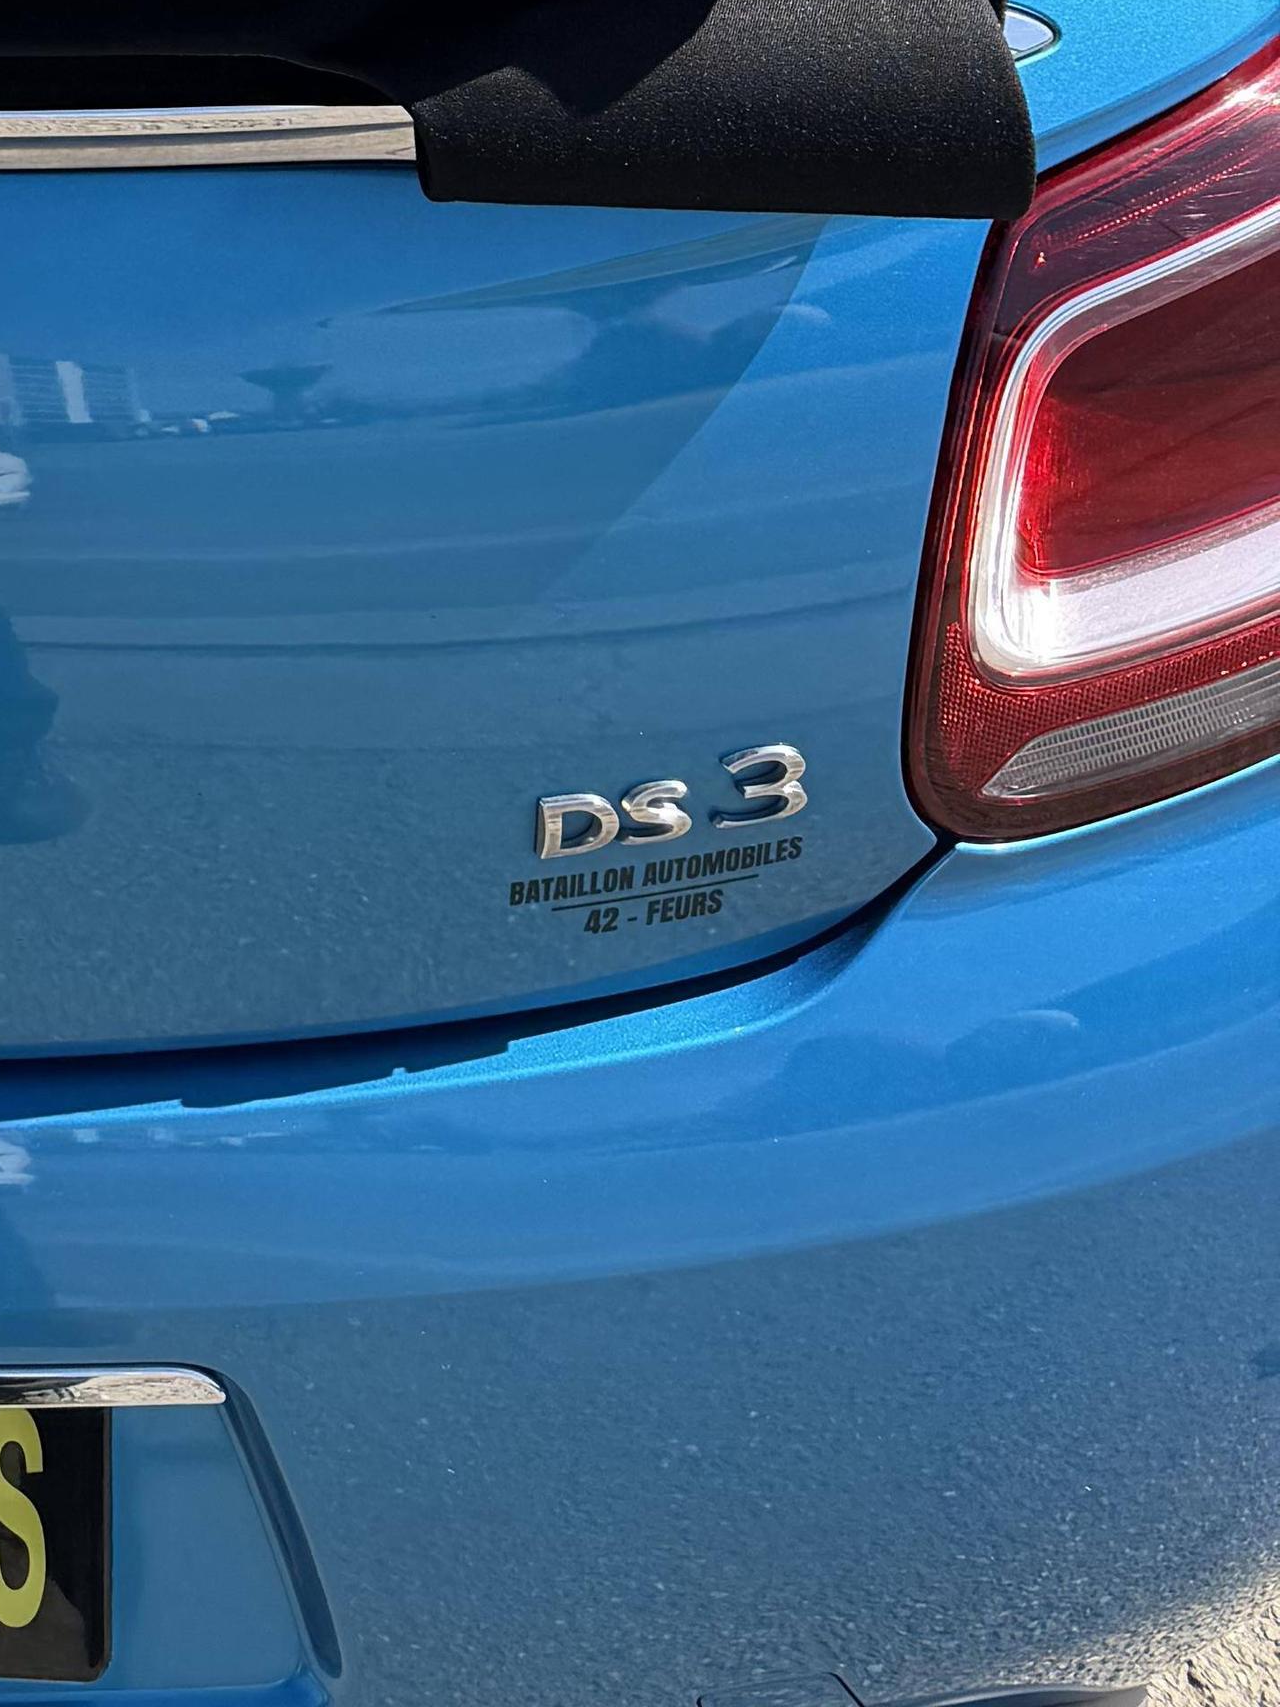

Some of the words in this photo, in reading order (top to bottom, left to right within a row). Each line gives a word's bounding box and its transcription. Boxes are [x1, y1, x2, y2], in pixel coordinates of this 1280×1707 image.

[536, 779, 692, 859] DS
[712, 743, 808, 828] 3
[509, 865, 635, 906] BATAILLON
[642, 836, 803, 887] AUTOMOBILES
[583, 907, 619, 934] 42
[646, 889, 724, 926] FEURS
